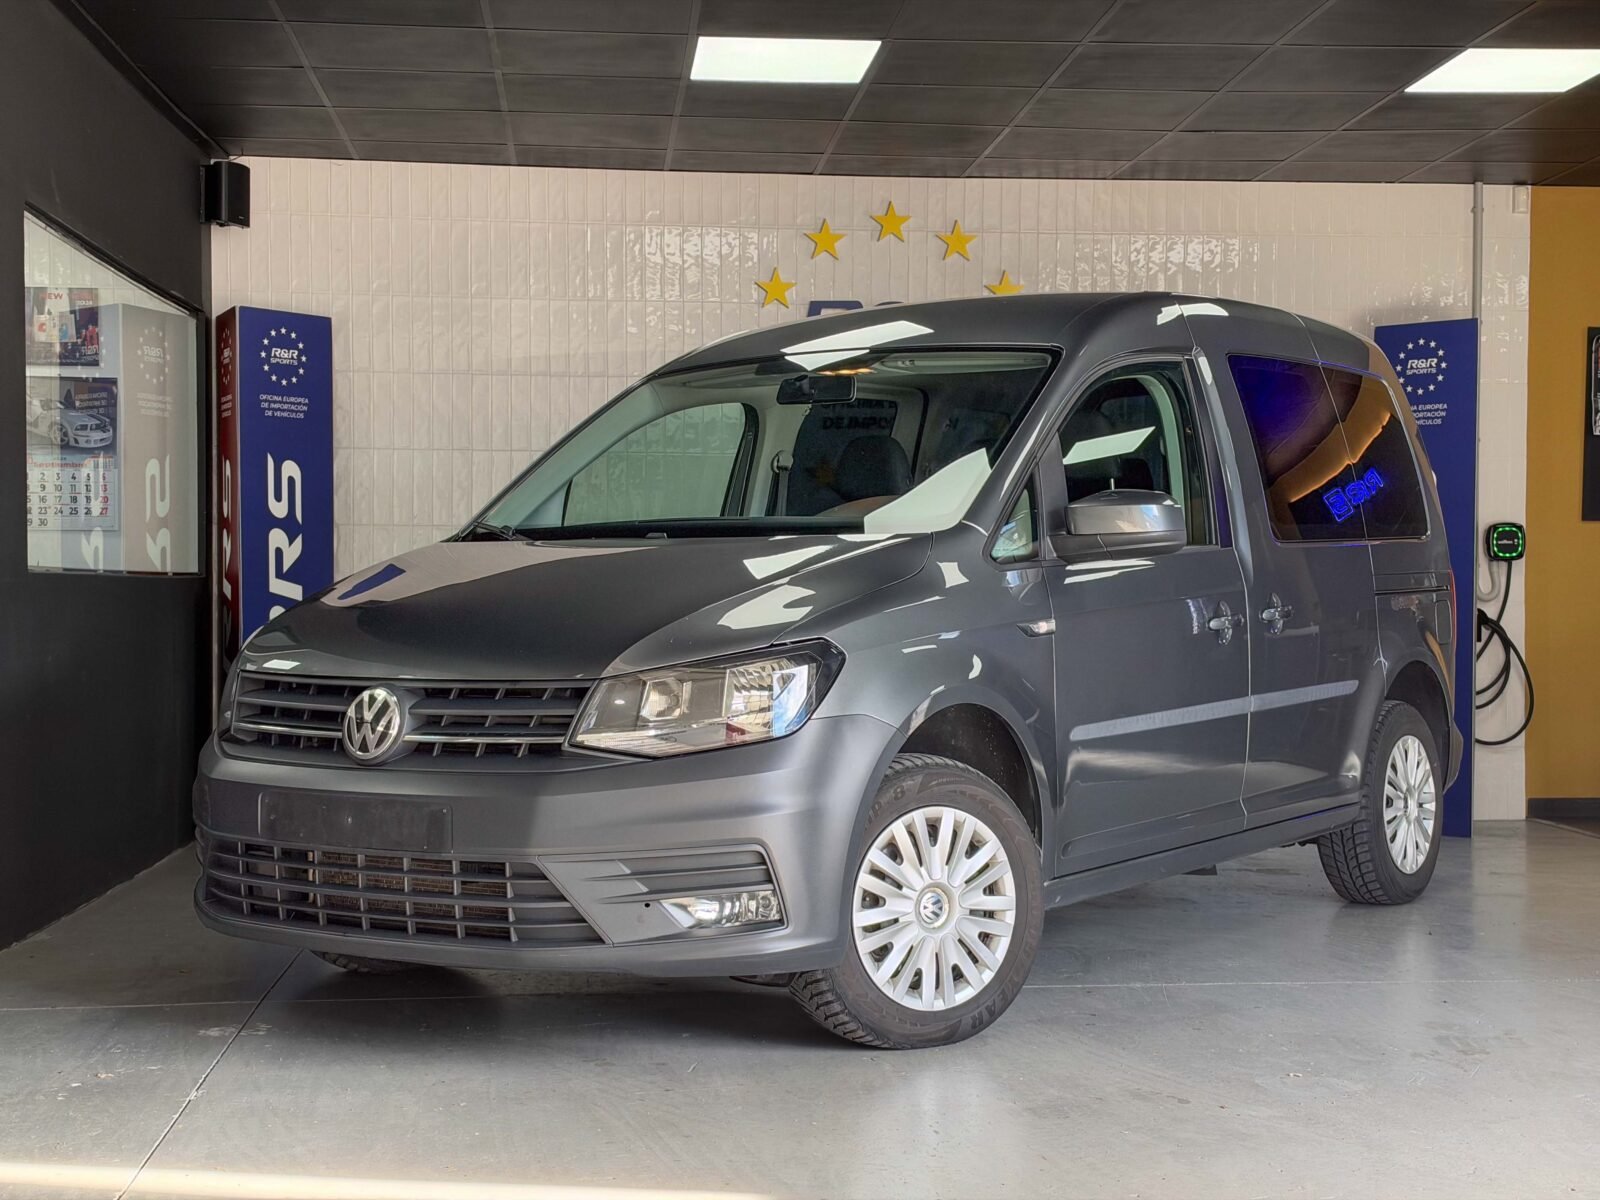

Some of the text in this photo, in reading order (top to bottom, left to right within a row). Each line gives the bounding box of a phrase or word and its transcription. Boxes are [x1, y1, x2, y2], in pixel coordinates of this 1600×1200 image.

[271, 347, 299, 360] R&R
[270, 357, 298, 366] SPORTS
[1408, 358, 1438, 368] R&R
[259, 394, 309, 404] OFICINA EUROPEA
[269, 402, 308, 412] IMPORTACIÓN
[1418, 403, 1448, 411] EUROPEA
[267, 452, 303, 624] RS
